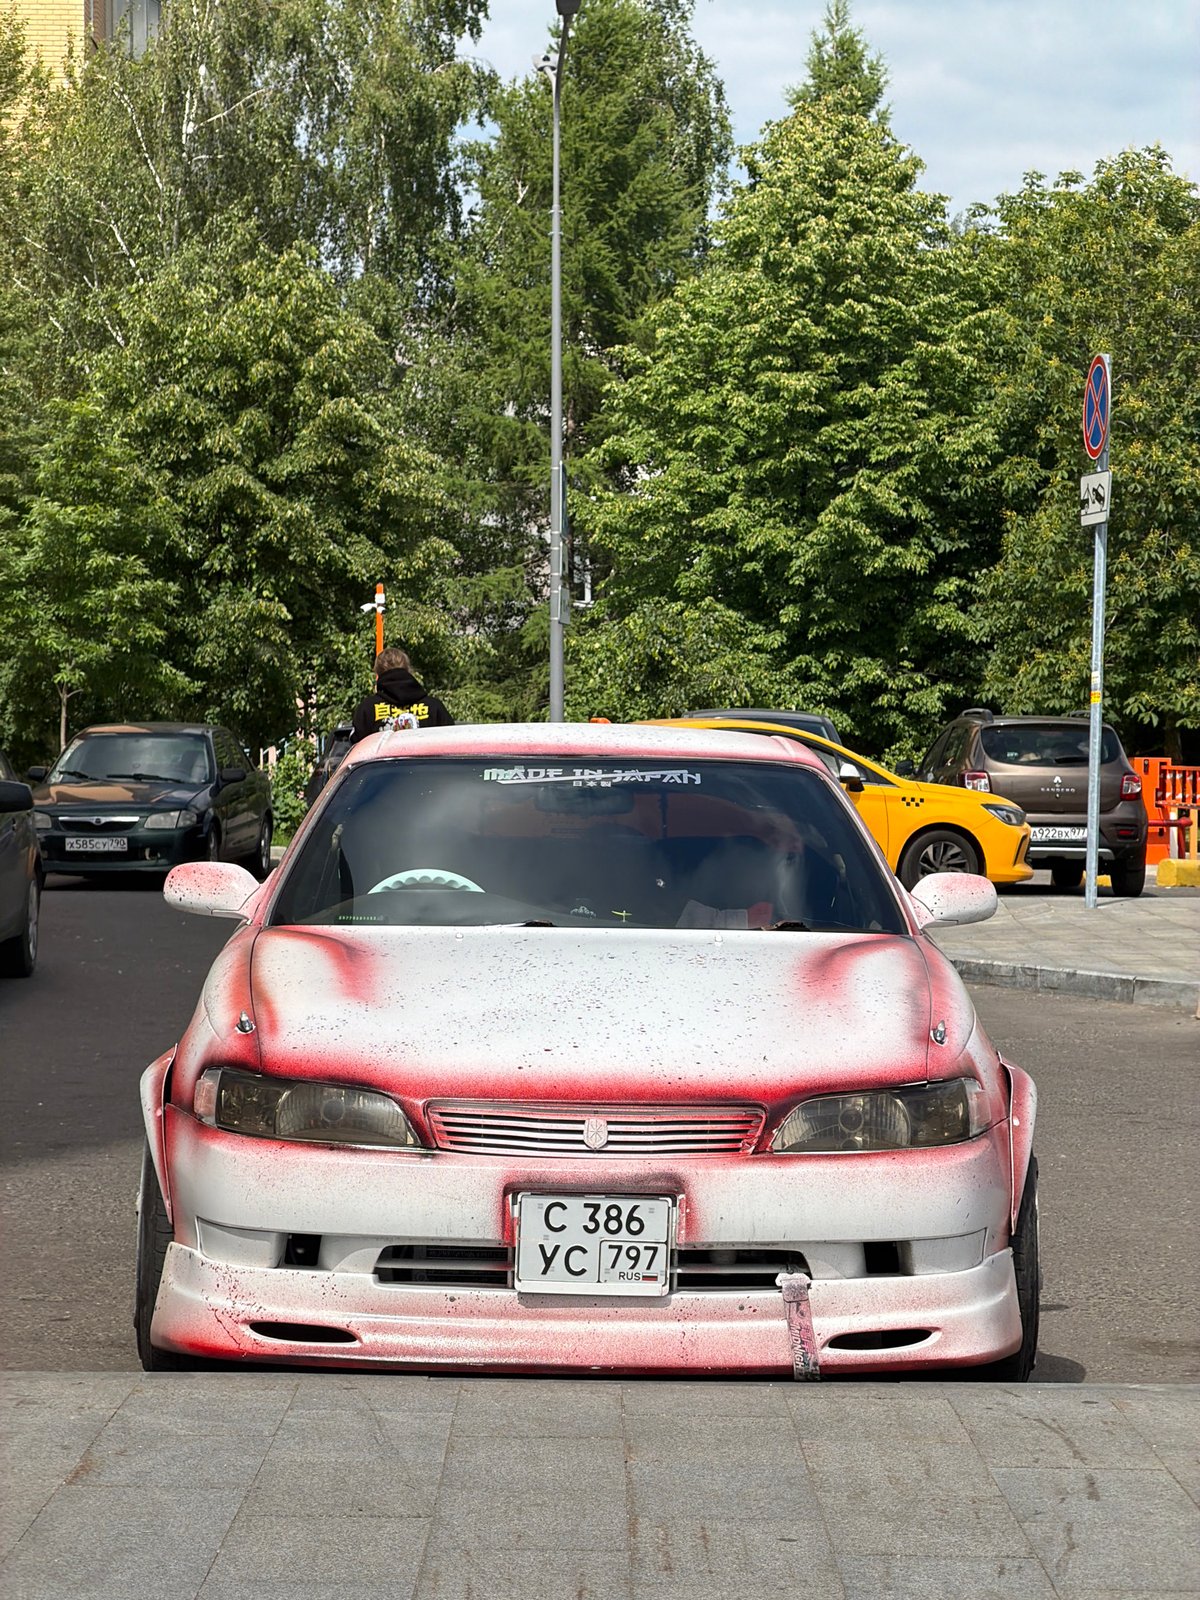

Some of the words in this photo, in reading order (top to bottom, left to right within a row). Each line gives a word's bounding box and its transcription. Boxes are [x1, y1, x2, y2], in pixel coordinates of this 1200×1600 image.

[483, 766, 563, 781] MADE
[572, 768, 603, 781] IN
[612, 770, 702, 785] JAPAN
[1032, 828, 1070, 839] А922ВХ
[544, 1202, 568, 1232] С
[582, 1203, 645, 1235] 386
[538, 1244, 588, 1276] УС
[608, 1245, 658, 1270] 797
[618, 1271, 641, 1281] RUS
